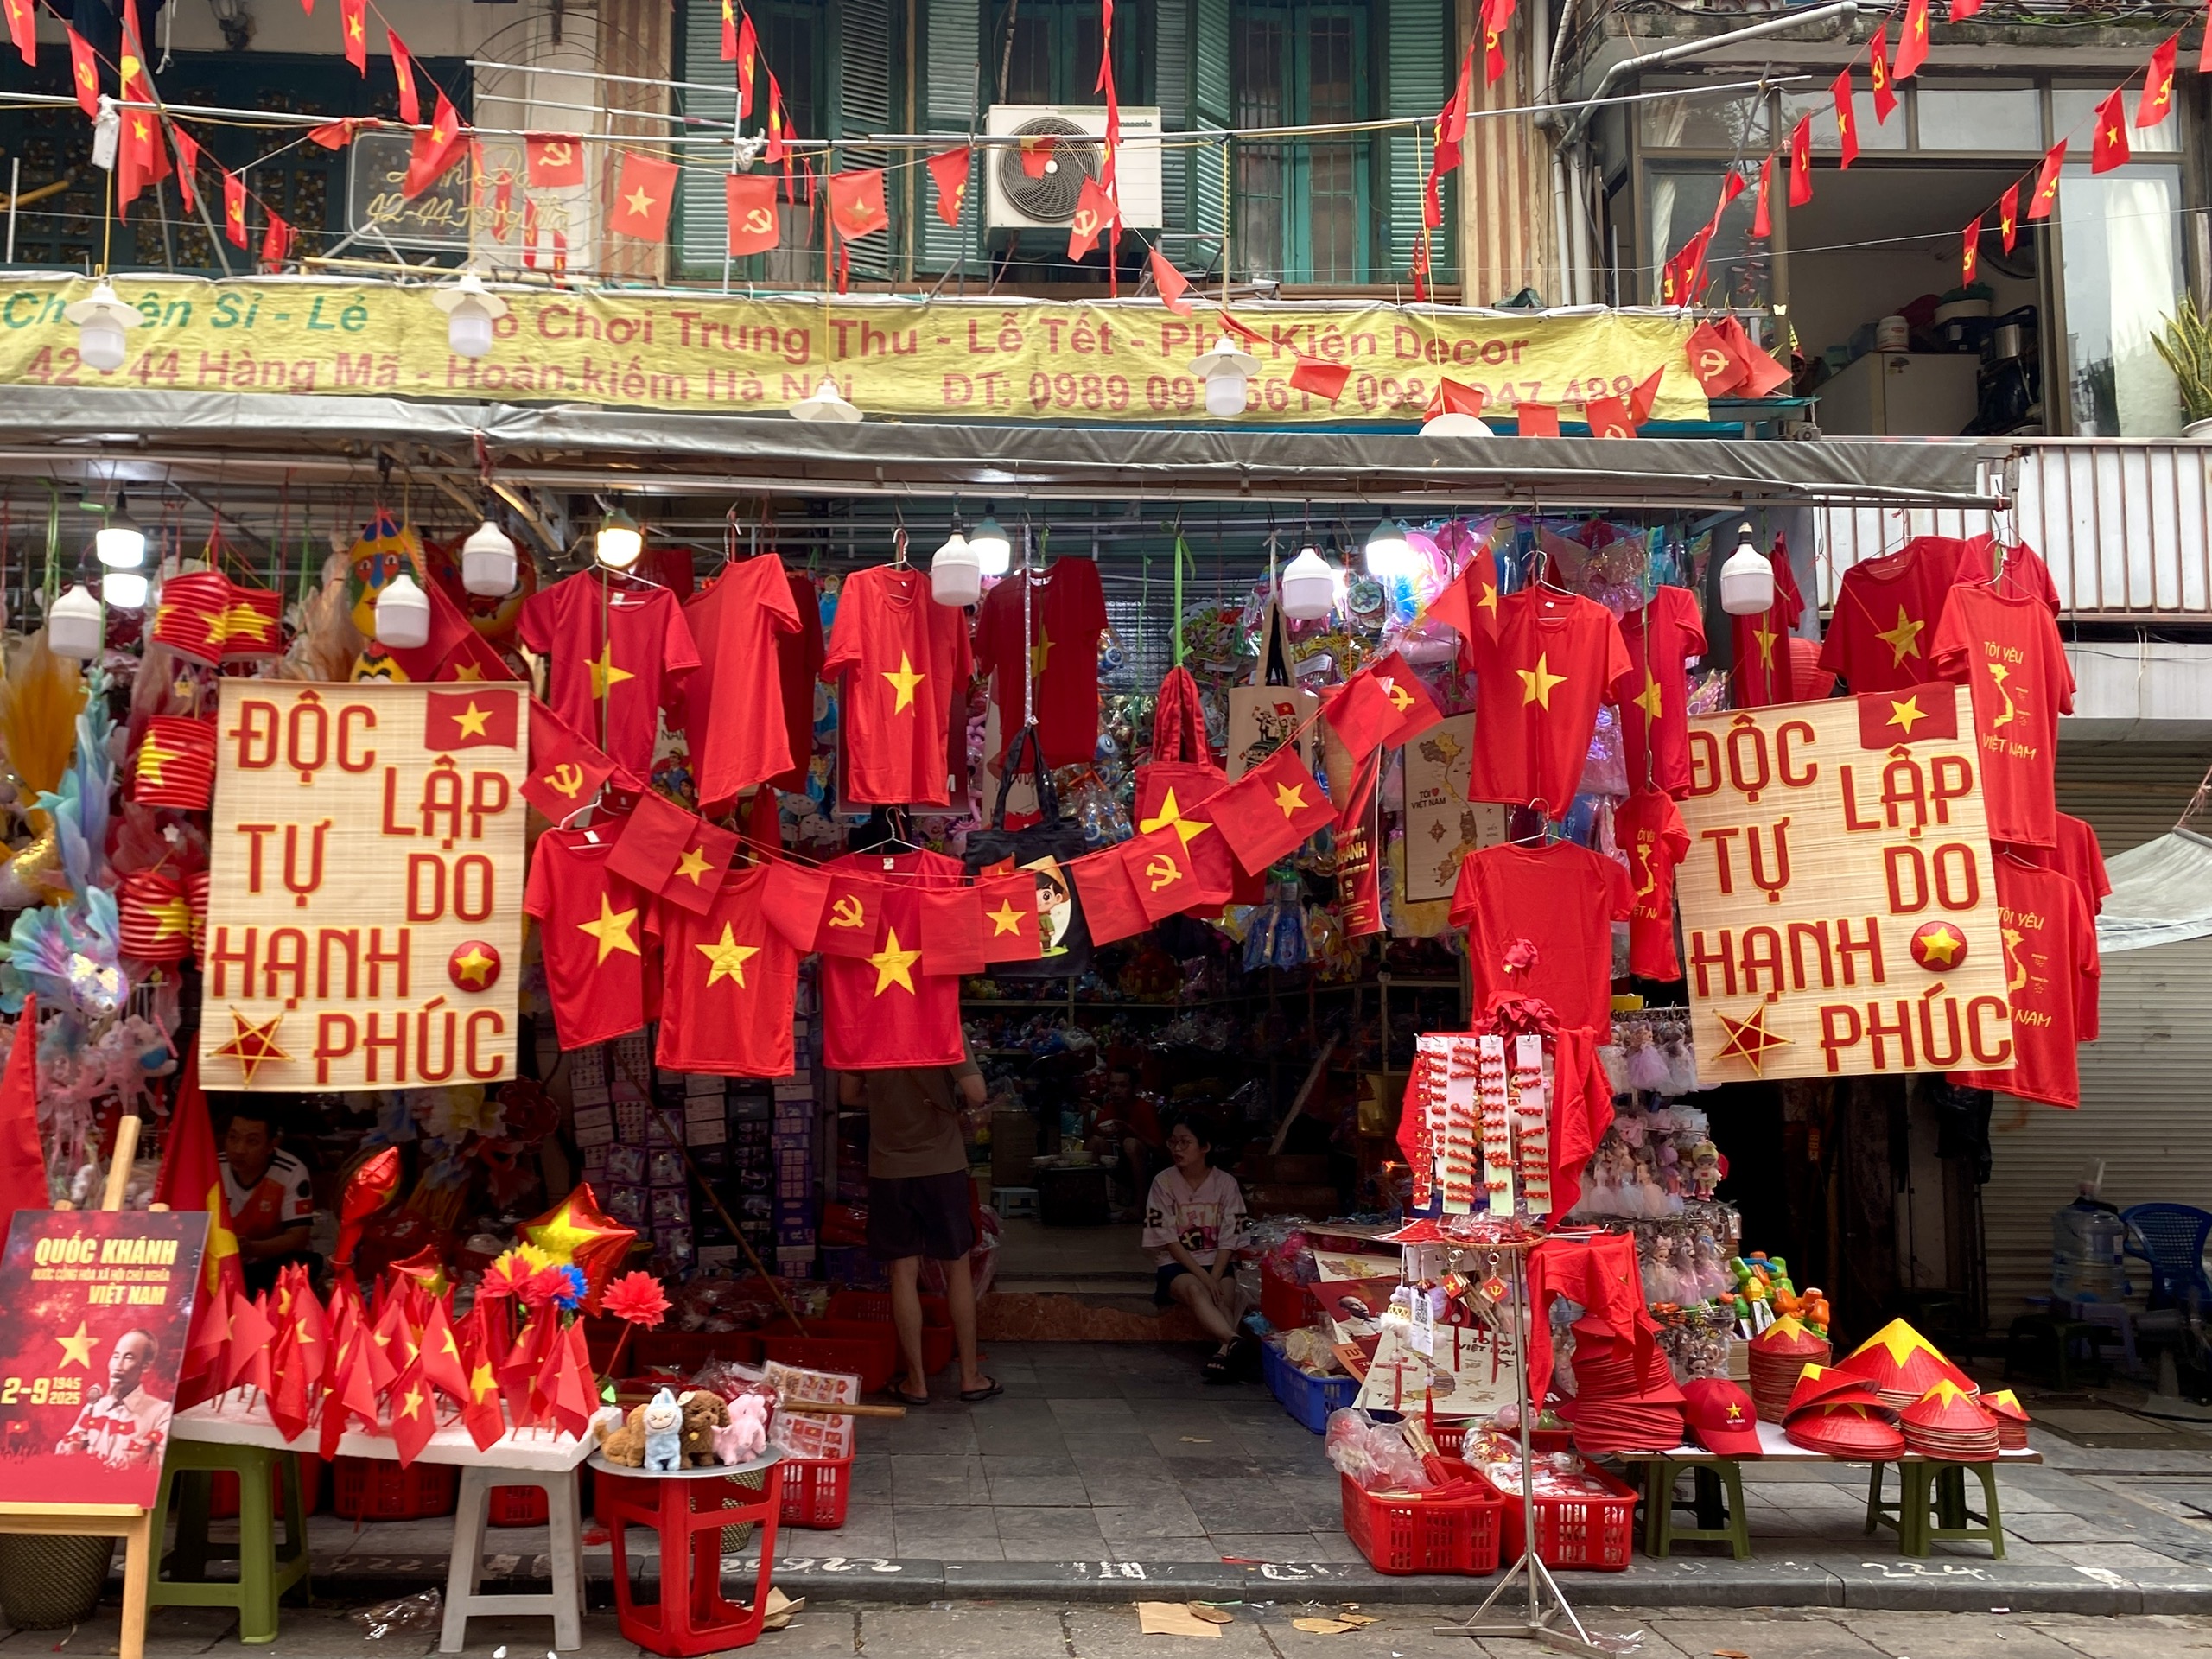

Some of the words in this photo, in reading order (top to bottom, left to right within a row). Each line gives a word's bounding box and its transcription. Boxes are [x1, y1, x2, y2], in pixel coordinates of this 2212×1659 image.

[3, 291, 192, 329] Chên
[307, 294, 368, 332] Lẻ
[537, 303, 652, 344] Chơi
[671, 311, 810, 364] Trung
[828, 319, 918, 358] Thu
[968, 312, 1024, 354] Lễ
[1039, 312, 1114, 355] Tết
[1396, 326, 1529, 366] Decor
[27, 346, 81, 385] 42
[128, 349, 181, 385] 44
[197, 350, 316, 395] Hàng
[582, 354, 689, 400] kiếm
[941, 371, 1011, 406] ĐT:
[1029, 372, 1129, 410] 0989
[1146, 374, 1207, 411] 09
[1357, 372, 1440, 413] 098
[1984, 642, 2000, 658] TÔI
[2003, 647, 2024, 664] YÊU
[228, 689, 378, 785] ĐỘC
[1689, 714, 1818, 804] ĐỘC
[2009, 742, 2037, 760] NAM
[382, 753, 511, 850] LẬP
[1840, 743, 1974, 839] LẬP
[237, 818, 332, 907] TỰ
[405, 853, 495, 924] DO
[1700, 817, 1791, 904] TỰ
[1883, 842, 1980, 915] DO
[2018, 912, 2044, 931] YÊU
[210, 926, 410, 1010] HẠNH
[1690, 916, 1885, 1003] HẠNH
[312, 995, 505, 1085] PHÚC
[1819, 982, 2012, 1074] PHÚC
[2014, 1010, 2052, 1028] NAM
[35, 1230, 97, 1266] QUỐC
[99, 1236, 178, 1265] KHÁNH
[87, 1282, 126, 1307] VIỆT
[127, 1285, 167, 1305] NAM
[0, 1376, 50, 1405] 2-9
[48, 1391, 81, 1405] 2025
[52, 1376, 82, 1389] 1945
